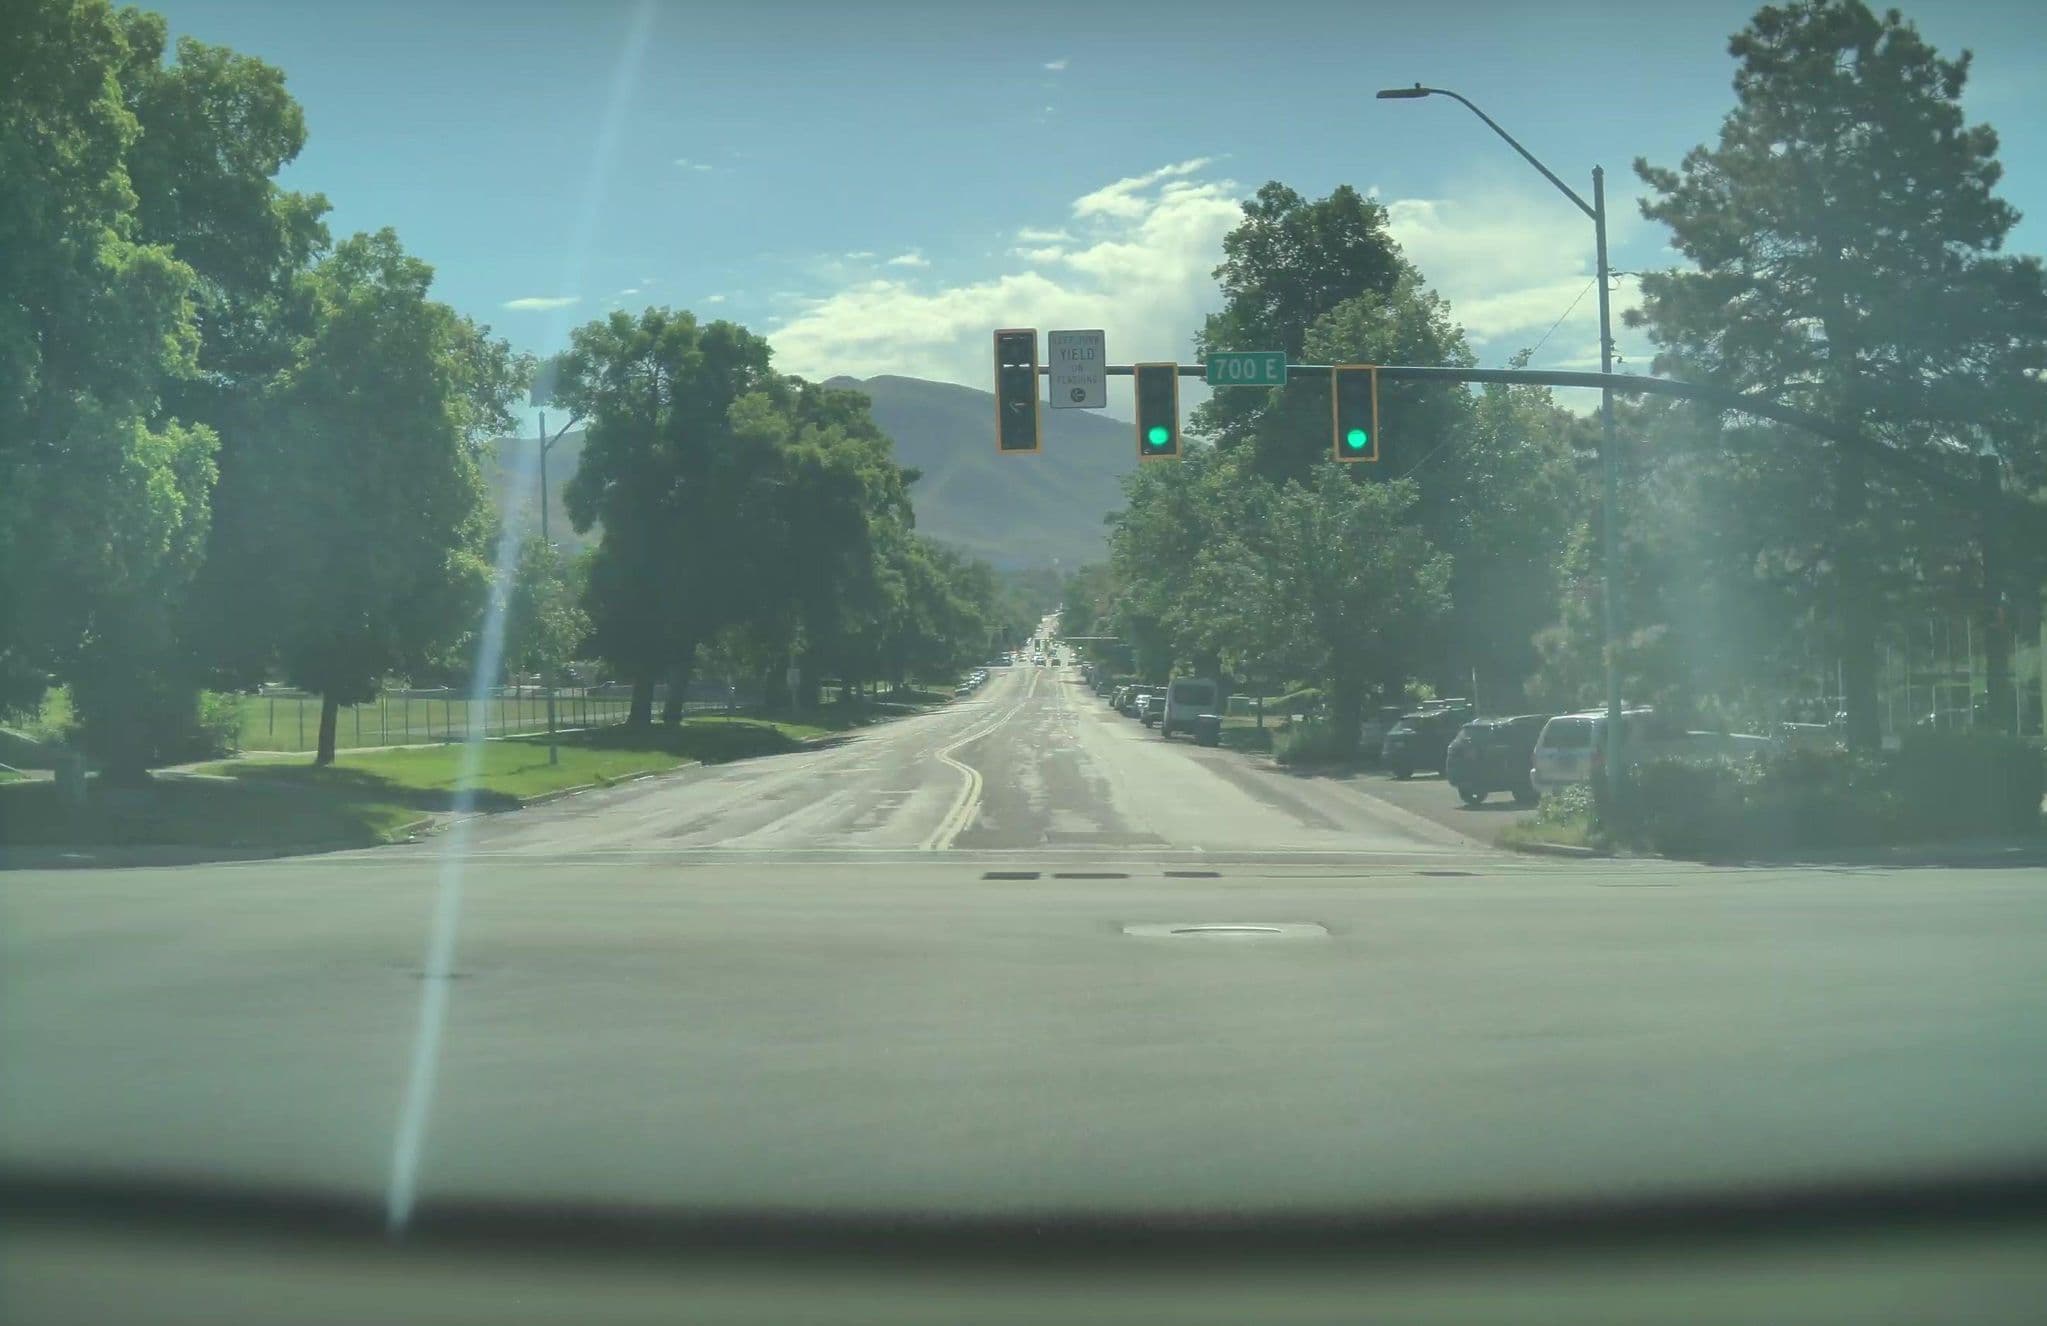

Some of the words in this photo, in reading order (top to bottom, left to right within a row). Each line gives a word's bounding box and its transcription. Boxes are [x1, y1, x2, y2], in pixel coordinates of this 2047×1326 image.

[1060, 348, 1095, 360] YIELD
[1215, 359, 1256, 379] 700
[1265, 359, 1278, 379] E
